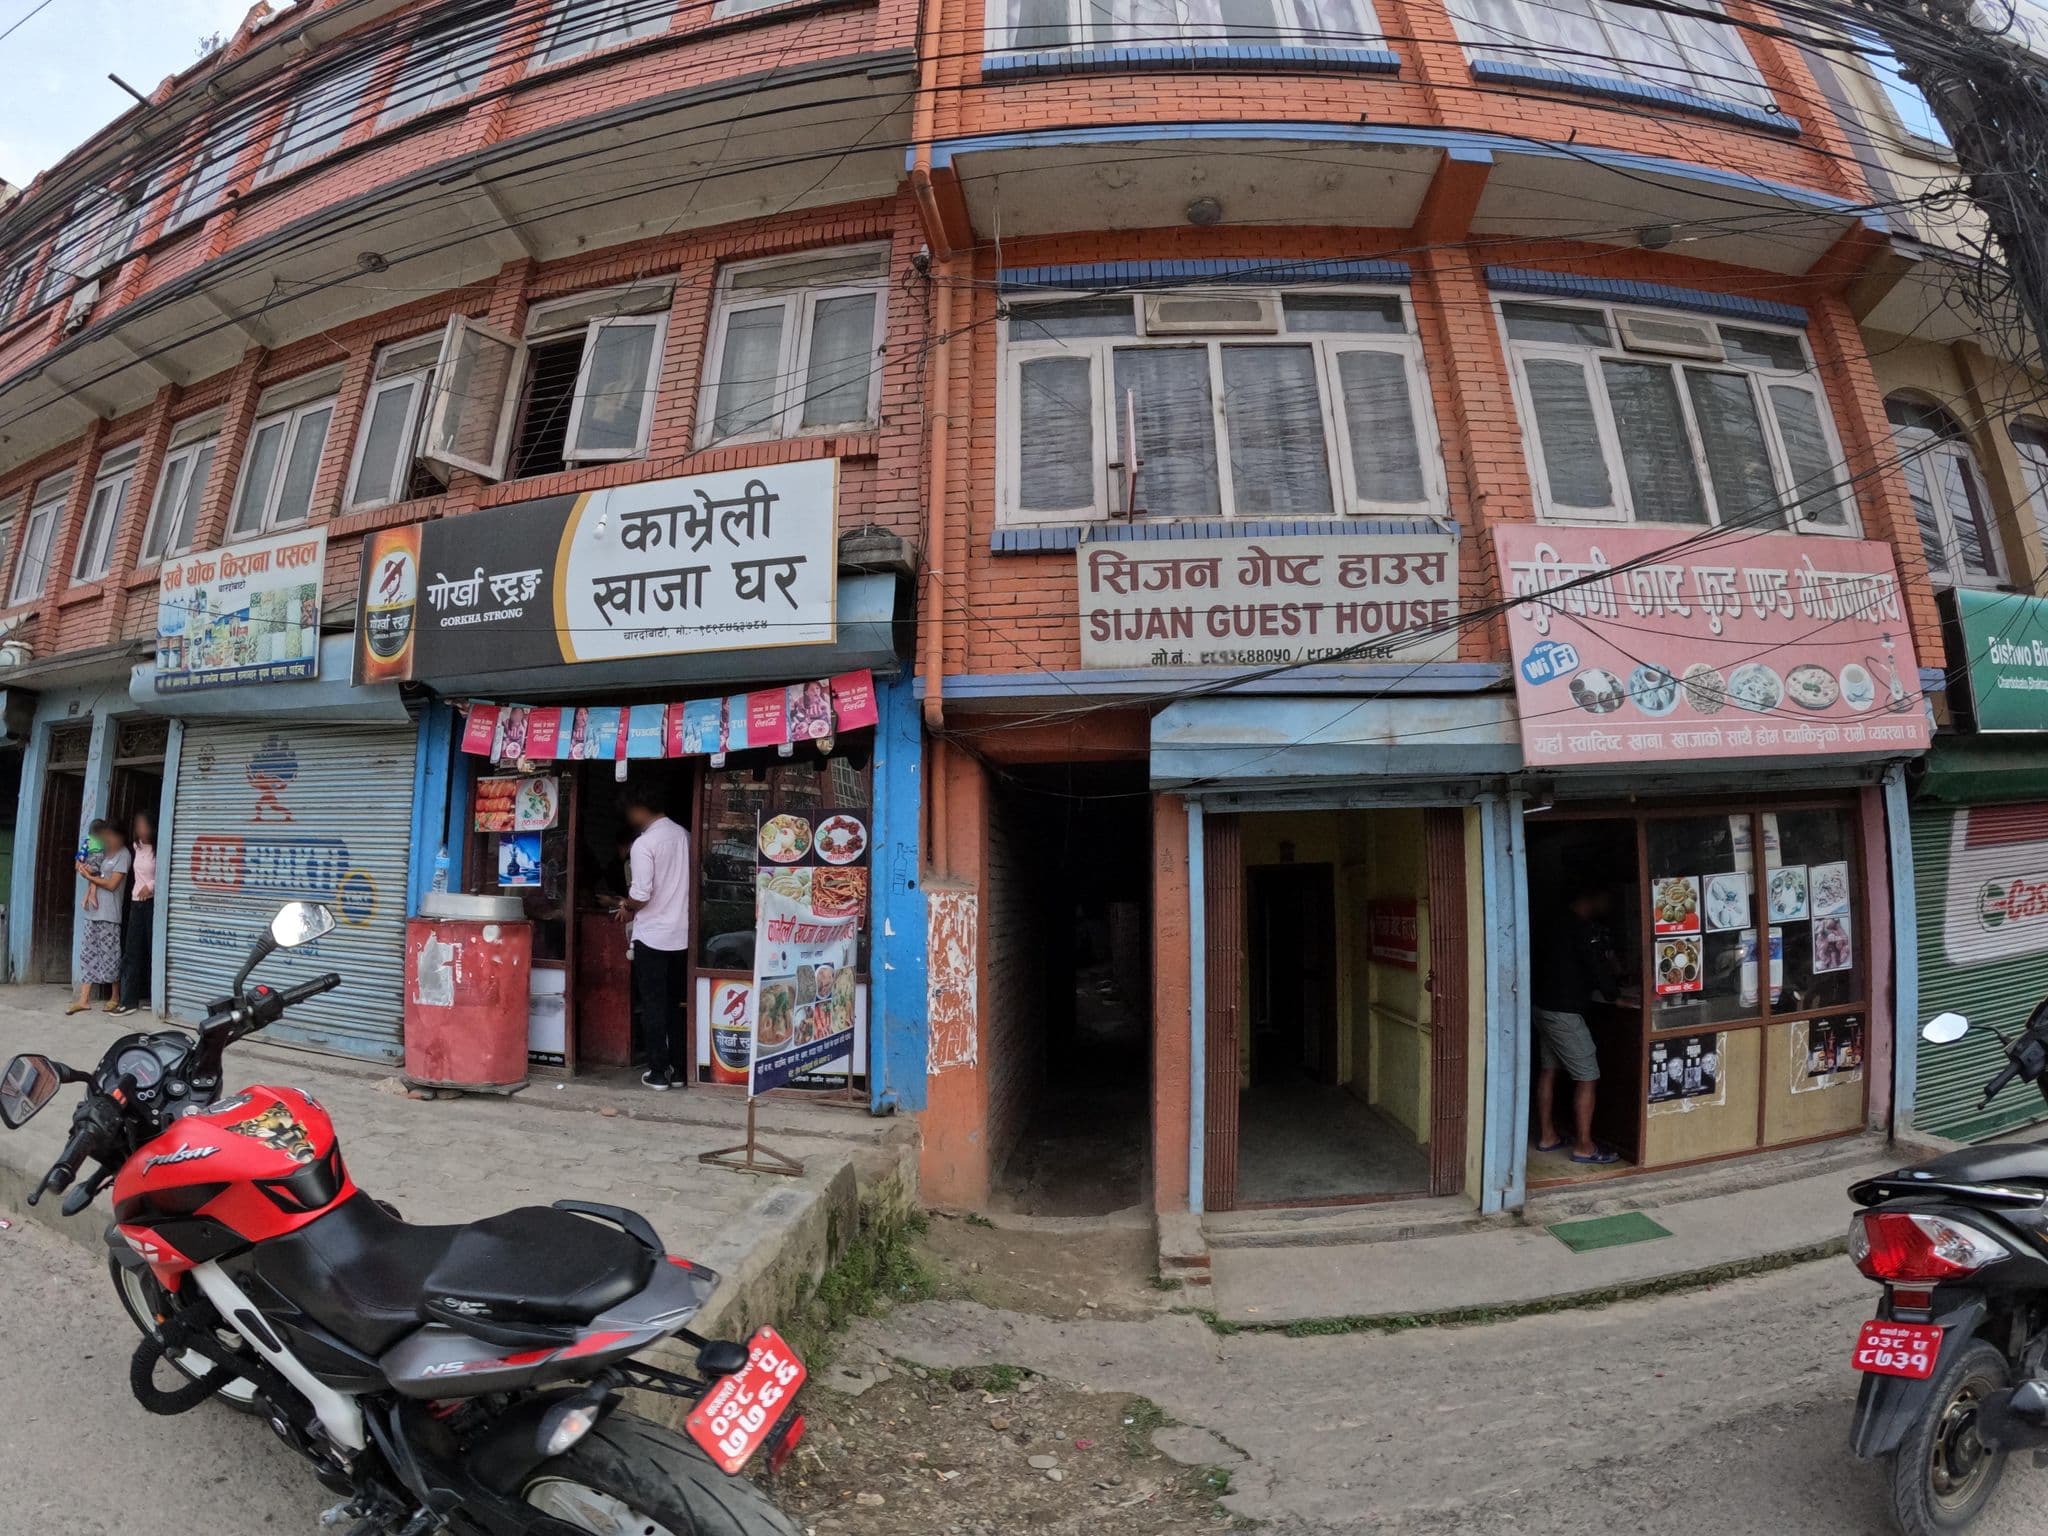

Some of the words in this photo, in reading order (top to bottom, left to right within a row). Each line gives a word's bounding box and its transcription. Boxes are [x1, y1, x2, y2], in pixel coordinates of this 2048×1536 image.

[621, 479, 780, 553] काभ्रेली
[164, 563, 183, 592] सबै
[187, 559, 216, 585] थोक
[220, 551, 271, 580] किराना
[276, 541, 319, 568] पसल
[1088, 549, 1223, 594] सिजन
[1237, 545, 1324, 588] गेष्ट
[1338, 552, 1448, 588] हाउस
[427, 567, 483, 611] गोर्खा
[592, 565, 711, 626] खाजा
[732, 555, 807, 610] घर
[1691, 566, 1742, 634] फुड
[1743, 567, 1795, 619] एण्ड
[1795, 553, 1902, 624] भोजनालय
[440, 615, 481, 628] GORKHA
[482, 608, 523, 622] STRONG
[1089, 606, 1194, 642] SIJAN
[1206, 603, 1324, 638] GUEST
[1336, 600, 1451, 635] HOUSE
[1534, 643, 1553, 654] Free
[1988, 636, 2031, 667] Bishwo
[421, 1361, 465, 1377] NS
